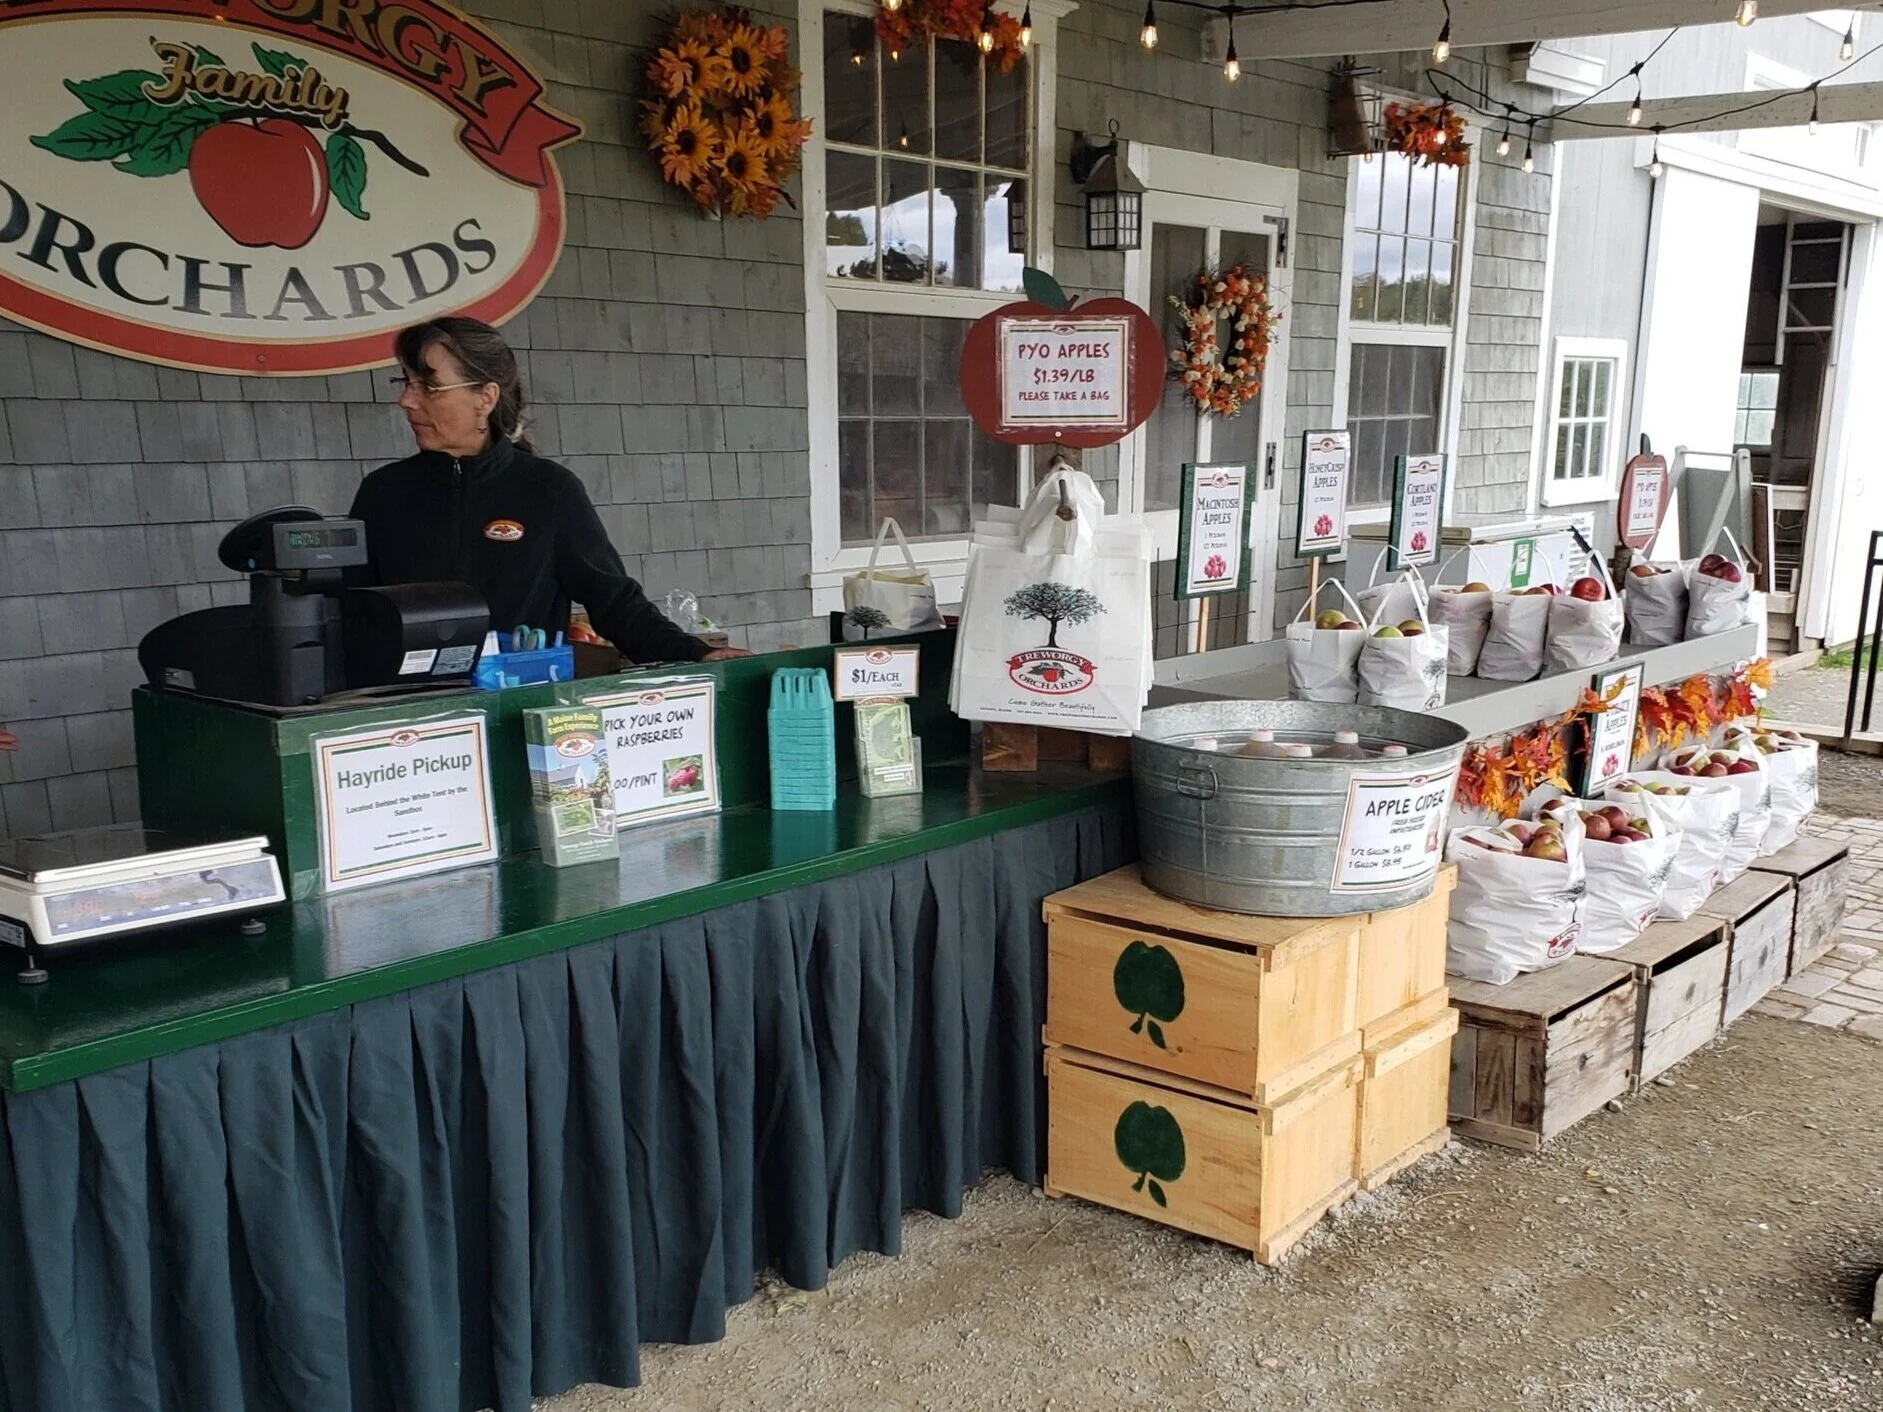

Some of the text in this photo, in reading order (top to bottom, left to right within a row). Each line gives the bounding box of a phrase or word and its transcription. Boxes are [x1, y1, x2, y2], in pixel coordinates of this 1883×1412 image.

[144, 41, 350, 130] Family
[1018, 342, 1110, 359] PYO APPLES
[1034, 368, 1095, 384] $1.39/LB
[1018, 390, 1110, 401] PLEASE TAKE A BAG
[1202, 512, 1231, 525] APPLES
[1016, 650, 1085, 667] TREWORGY
[851, 668, 899, 684] $1/EACH
[1018, 673, 1084, 690] ORCHARDS
[604, 708, 695, 733] PICK YOUR OWN
[616, 726, 684, 749] RASPBERRIES
[337, 754, 473, 789] Hayride Pickup
[346, 803, 374, 814] Located
[375, 798, 398, 809] Behind
[400, 796, 410, 804] the
[412, 793, 431, 801] White
[432, 790, 447, 798] Tent
[1365, 789, 1445, 817] APPLE CIDER
[394, 806, 423, 817] Sandbox
